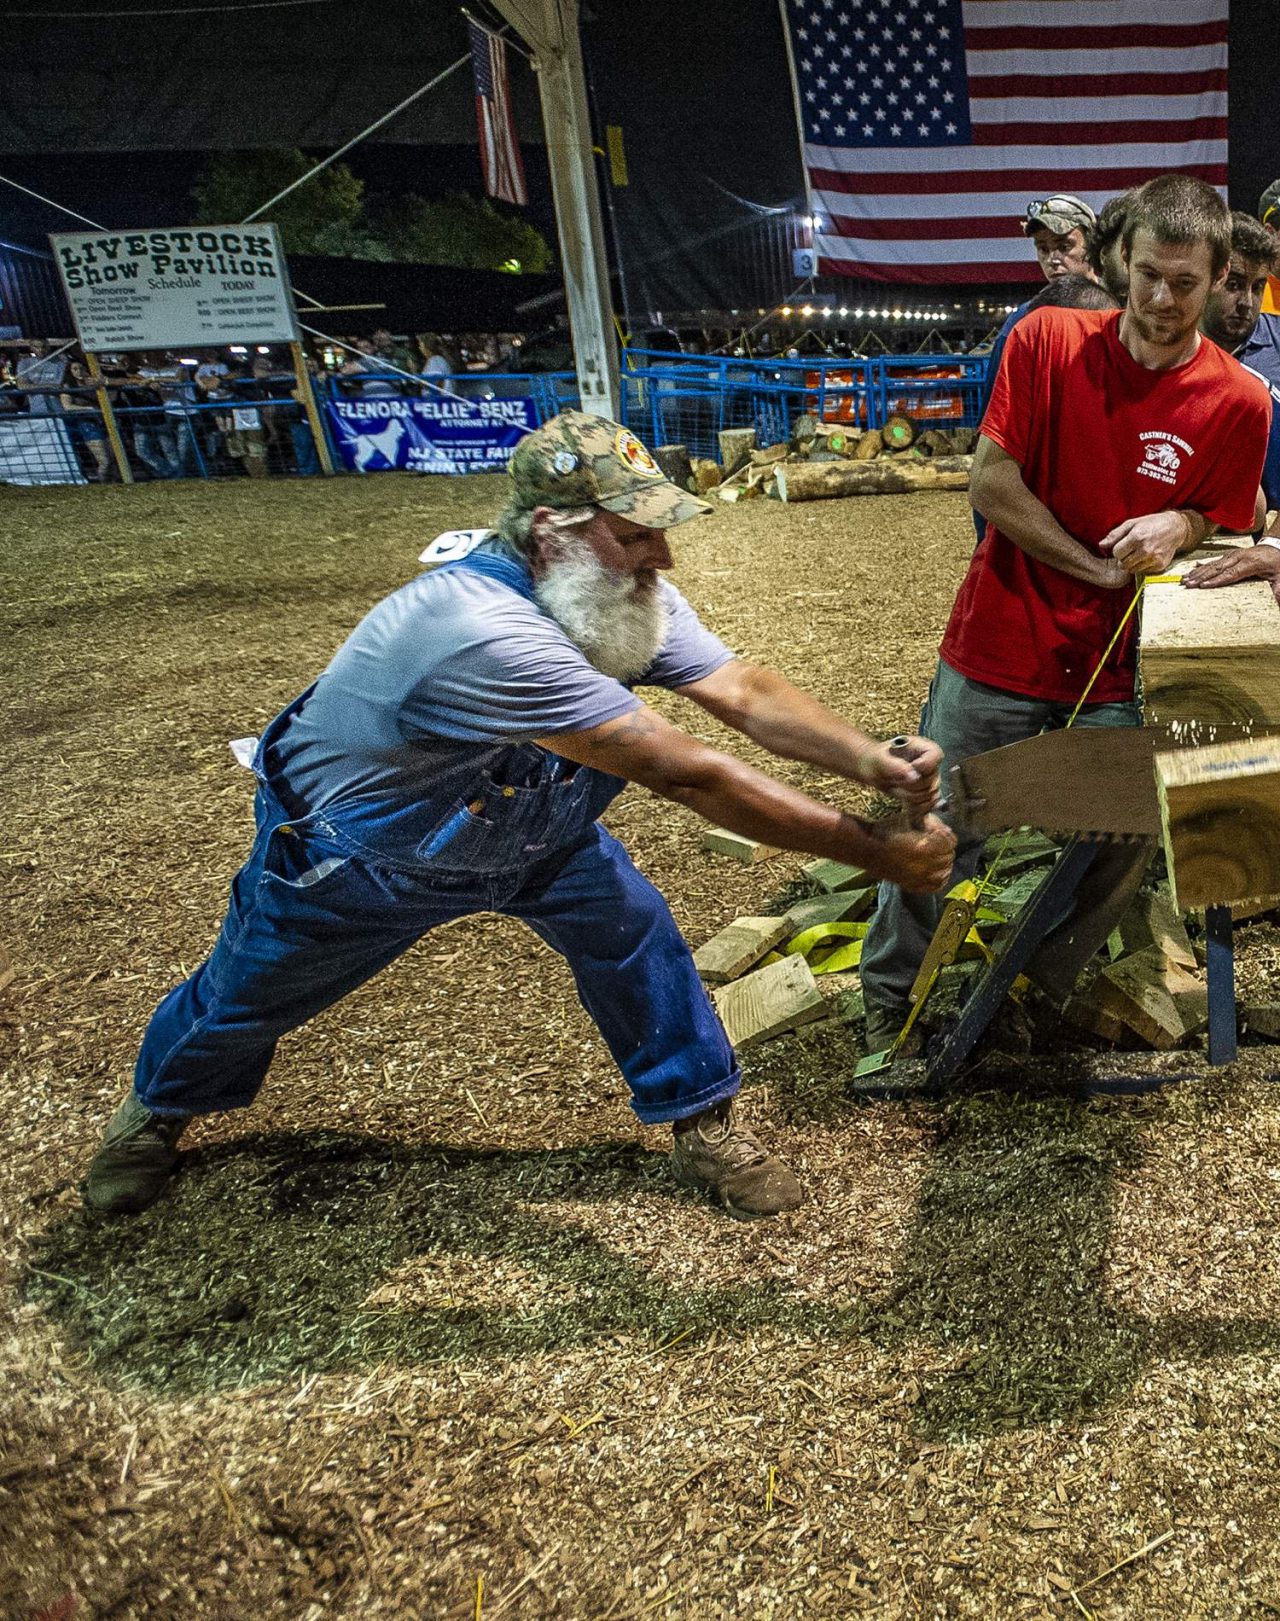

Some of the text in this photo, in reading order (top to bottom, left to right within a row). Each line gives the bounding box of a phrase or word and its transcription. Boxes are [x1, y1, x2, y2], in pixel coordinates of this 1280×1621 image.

[60, 232, 274, 268] LIVESTOCK
[801, 254, 813, 271] 3
[65, 254, 277, 289] Show Pavilion
[147, 275, 201, 290] Schedule
[221, 280, 256, 290] TODAY
[90, 286, 136, 295] Tomorrow
[408, 447, 430, 460] NJ
[434, 447, 483, 460] STATE
